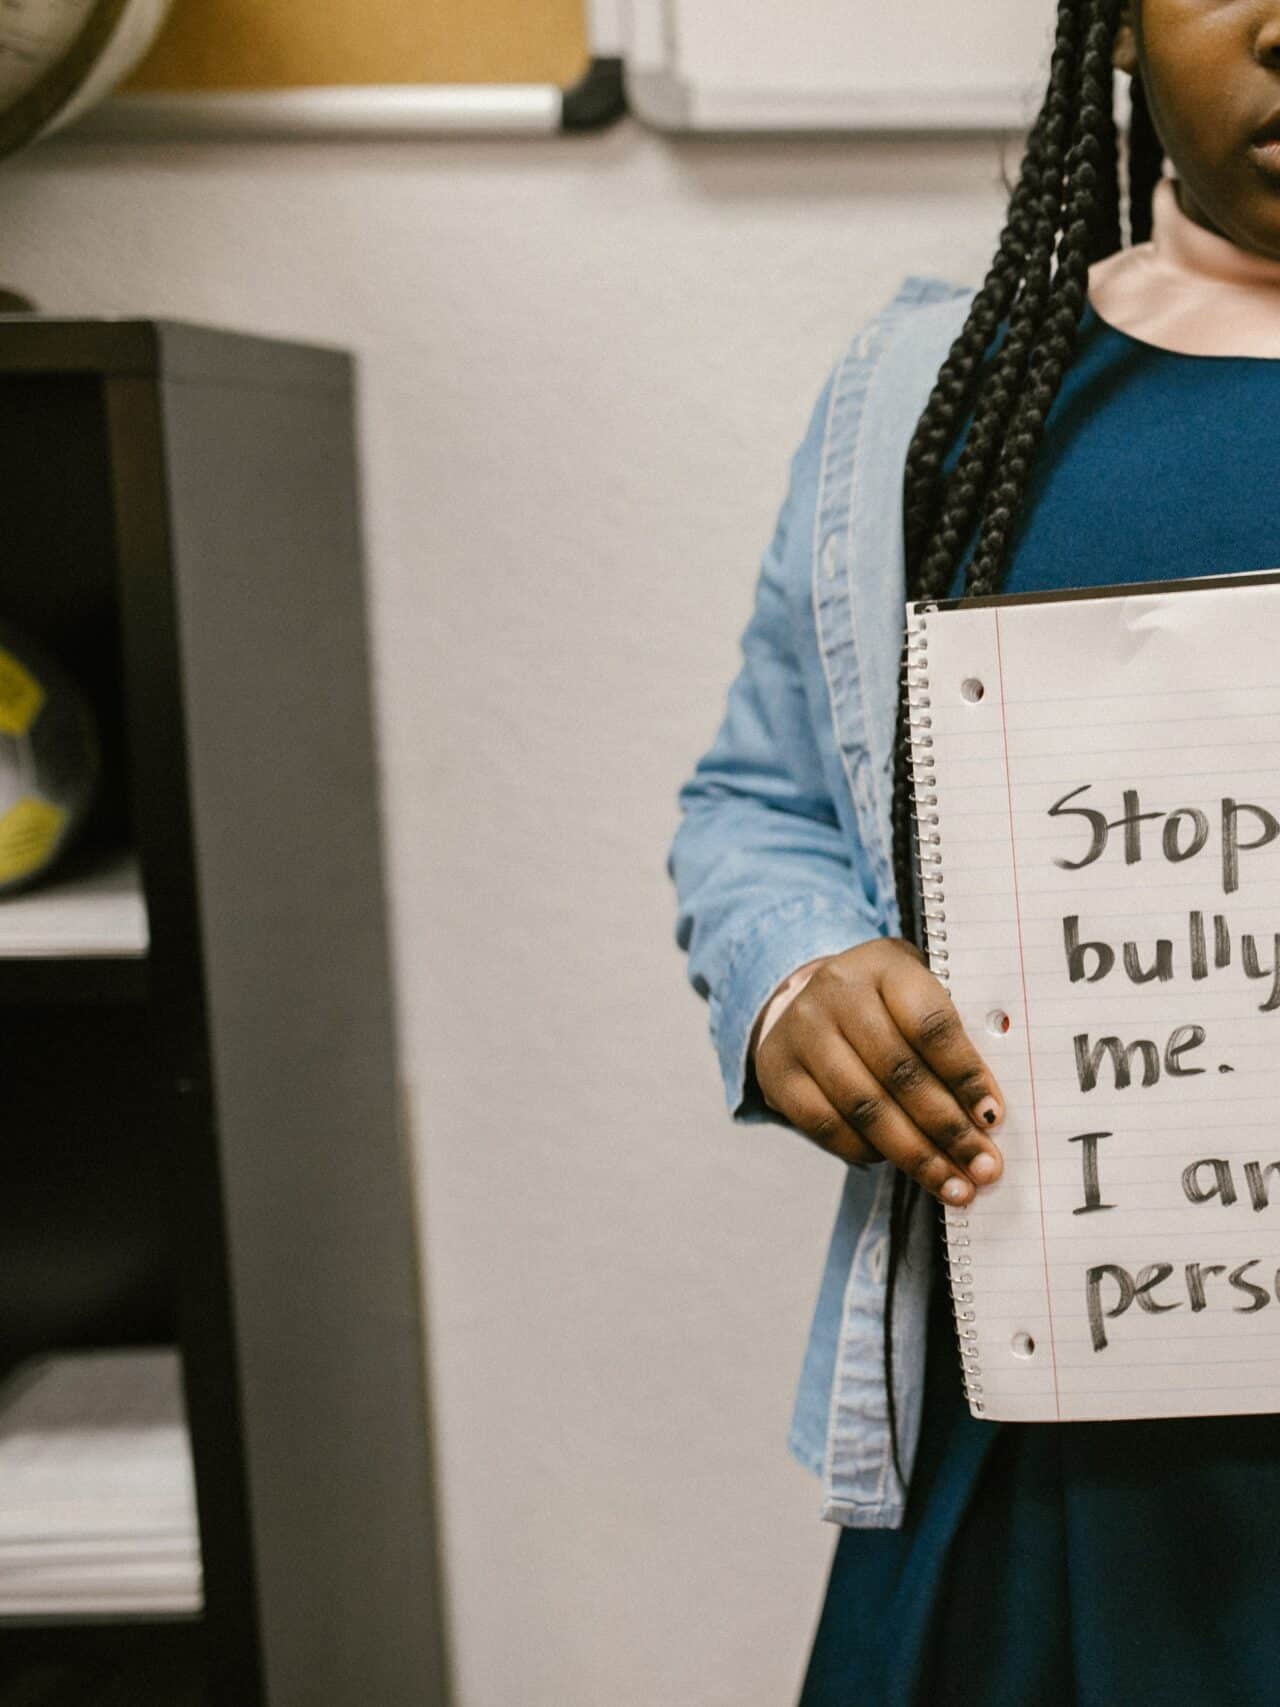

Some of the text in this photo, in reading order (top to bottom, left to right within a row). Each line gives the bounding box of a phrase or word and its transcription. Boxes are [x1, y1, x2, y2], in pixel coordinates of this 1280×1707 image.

[1047, 784, 1280, 895] Stop
[1073, 1023, 1235, 1094] me.
[1069, 1131, 1117, 1216] I
